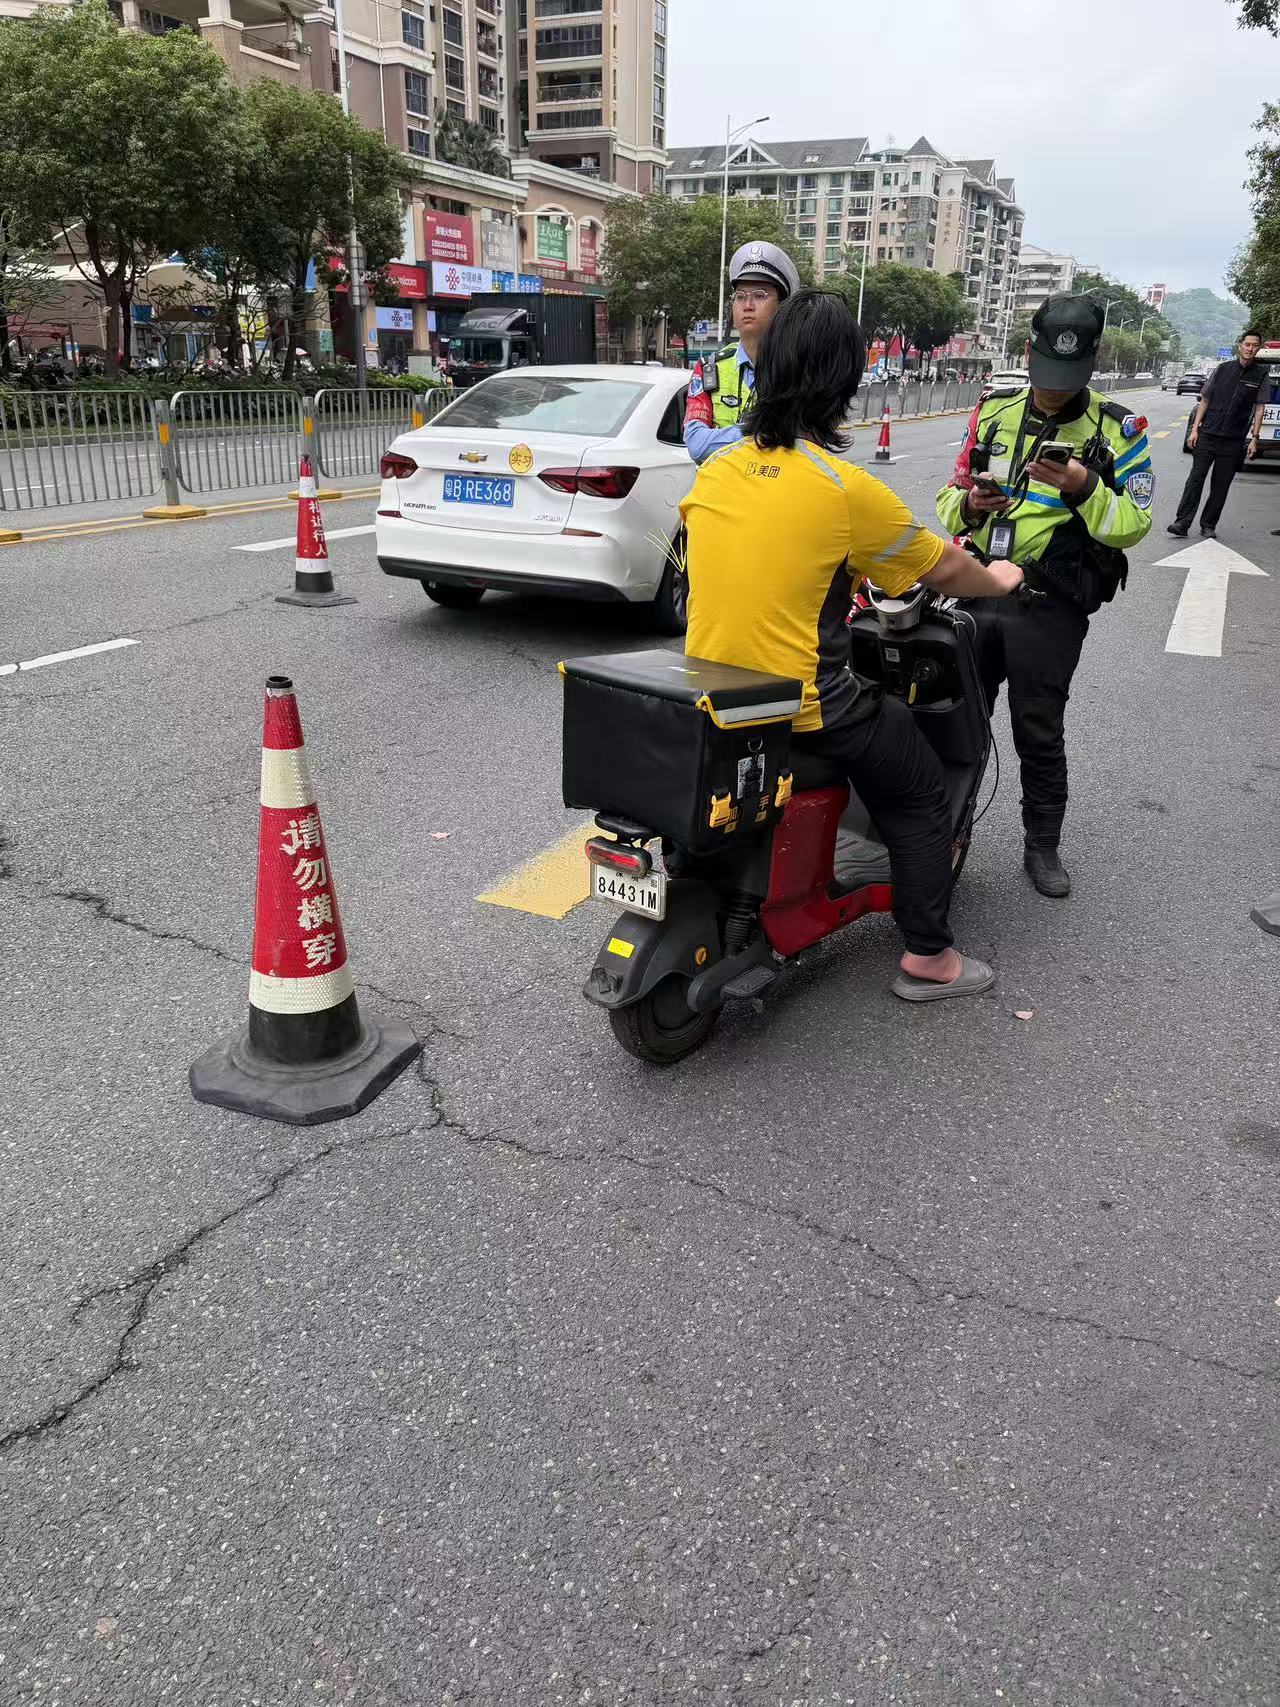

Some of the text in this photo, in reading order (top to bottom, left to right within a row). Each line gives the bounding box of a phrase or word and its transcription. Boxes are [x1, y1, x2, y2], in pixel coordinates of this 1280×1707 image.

[472, 320, 498, 329] JAC
[697, 323, 703, 334] P
[511, 450, 532, 468] 实习
[757, 465, 780, 479] 美团
[308, 500, 327, 557] 礼让行人
[279, 812, 337, 969] 请勿横穿
[598, 876, 657, 910] 84431M
